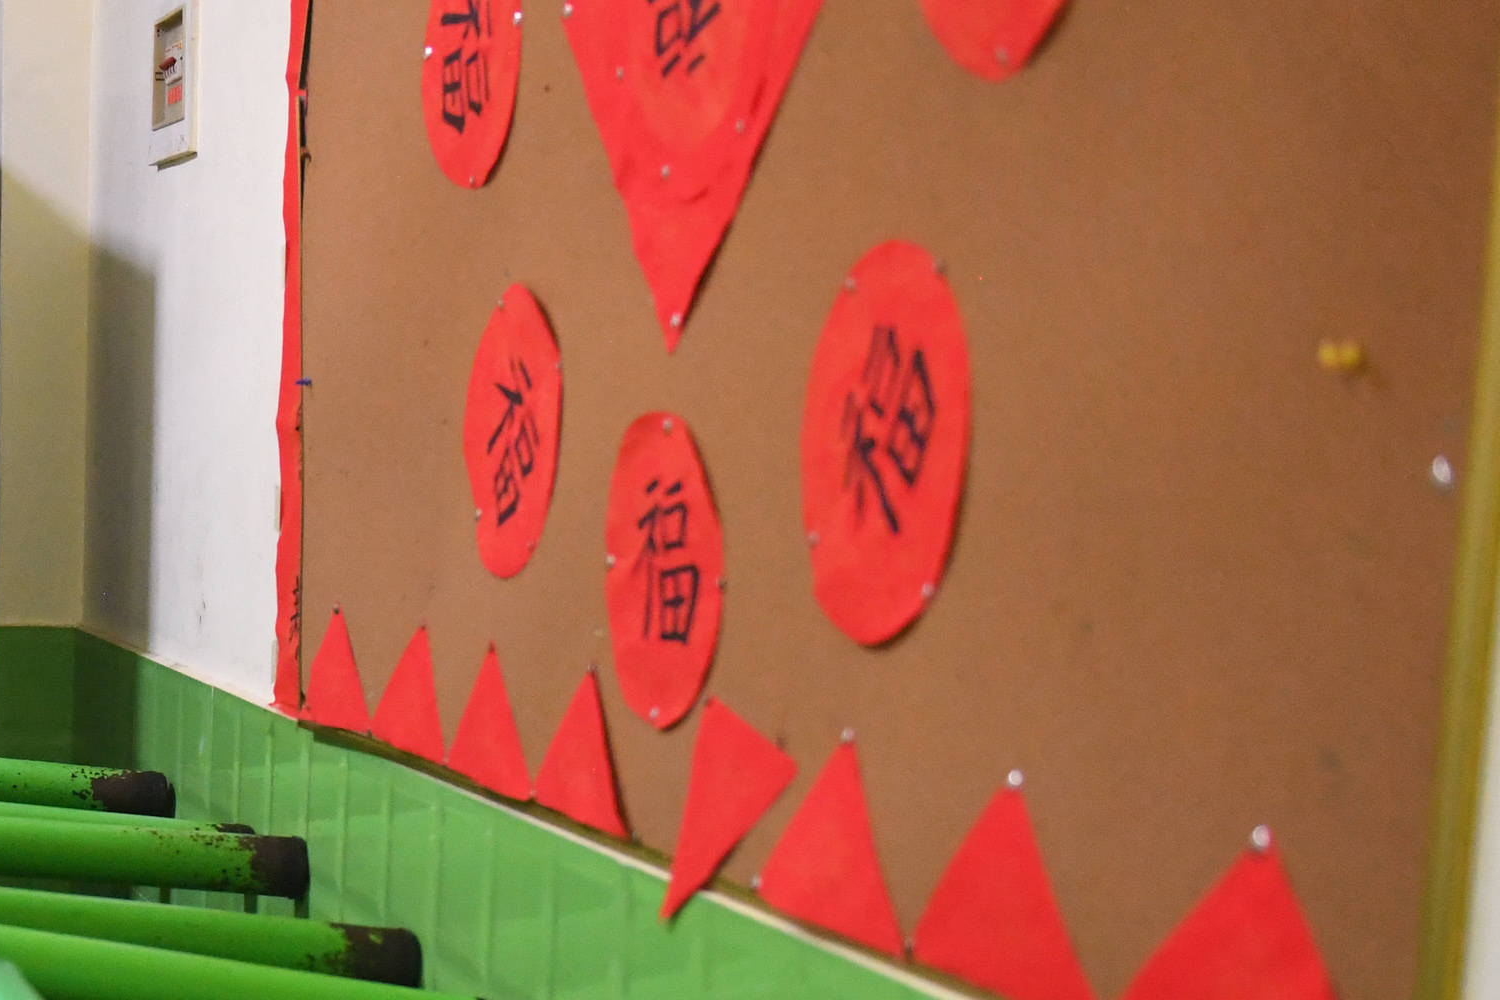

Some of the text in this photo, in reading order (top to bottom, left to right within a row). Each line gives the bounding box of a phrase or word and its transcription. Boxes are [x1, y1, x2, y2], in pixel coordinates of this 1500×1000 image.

[487, 358, 541, 527] 福
[842, 324, 936, 534] 福
[631, 478, 700, 645] 福
